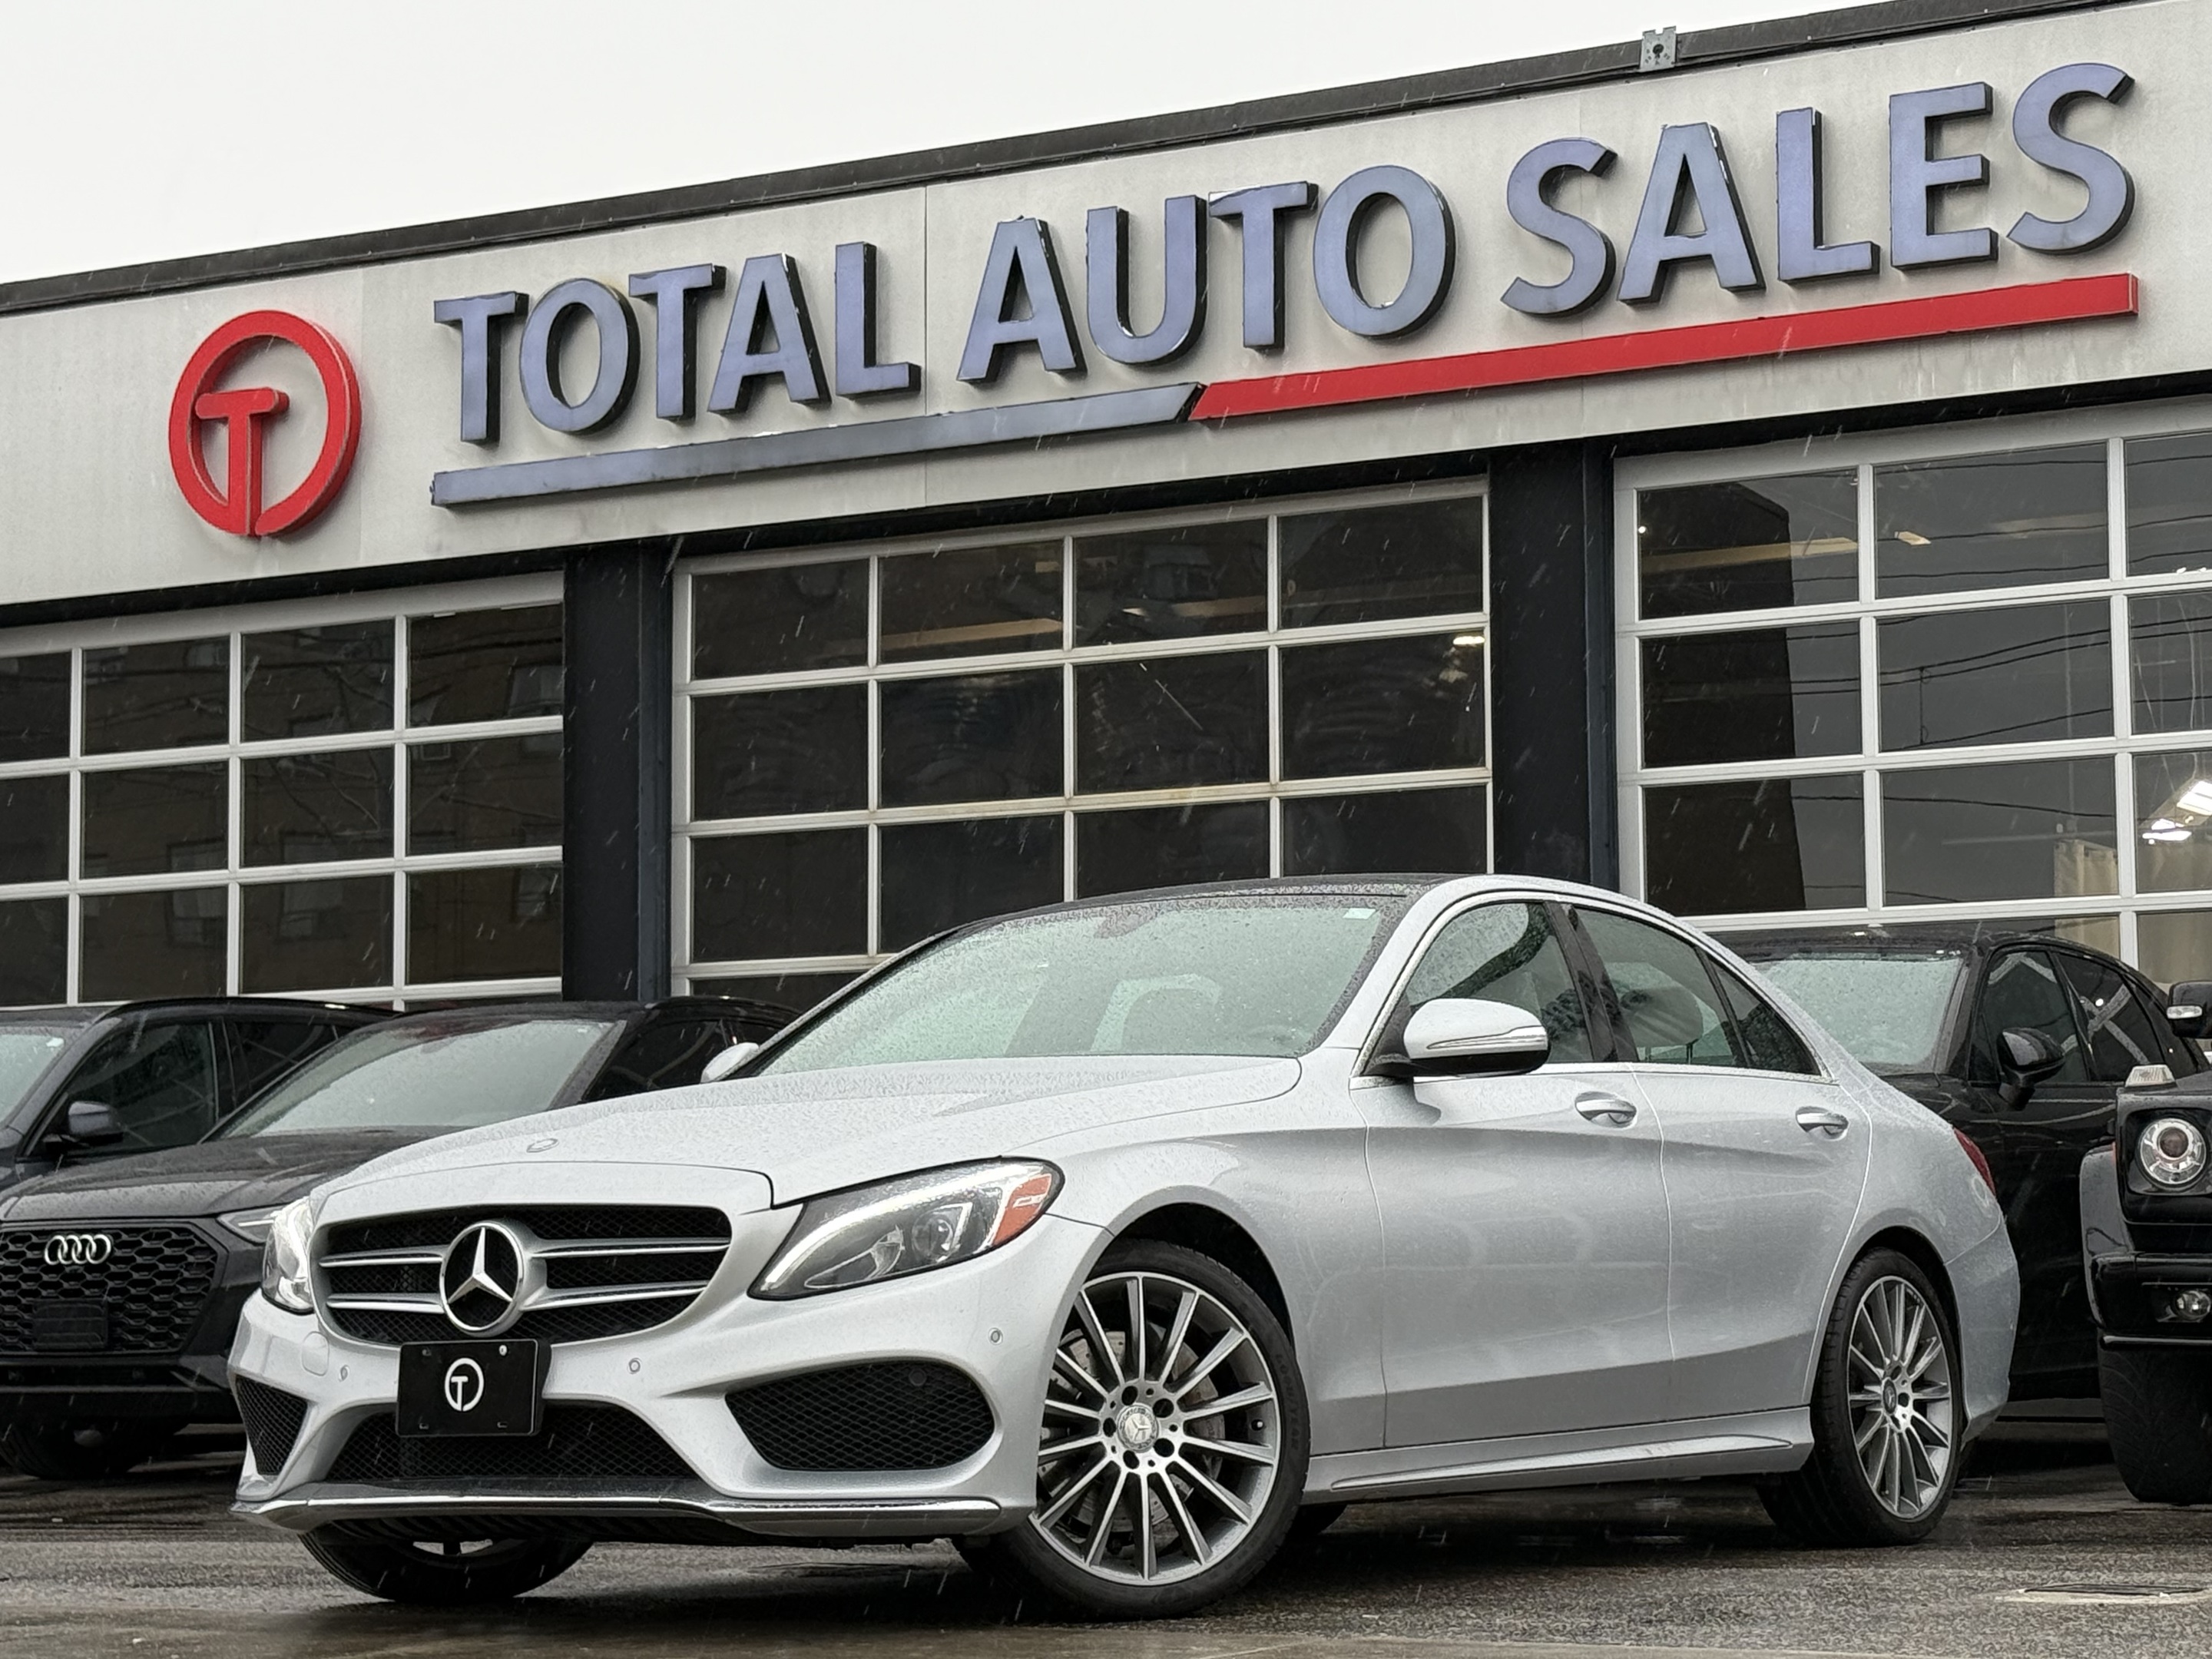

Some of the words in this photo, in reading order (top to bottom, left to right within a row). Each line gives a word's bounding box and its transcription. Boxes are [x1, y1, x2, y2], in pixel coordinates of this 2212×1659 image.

[434, 241, 921, 446] TOTAL
[957, 164, 1455, 386] AUTO
[1500, 63, 2134, 317] SALES
